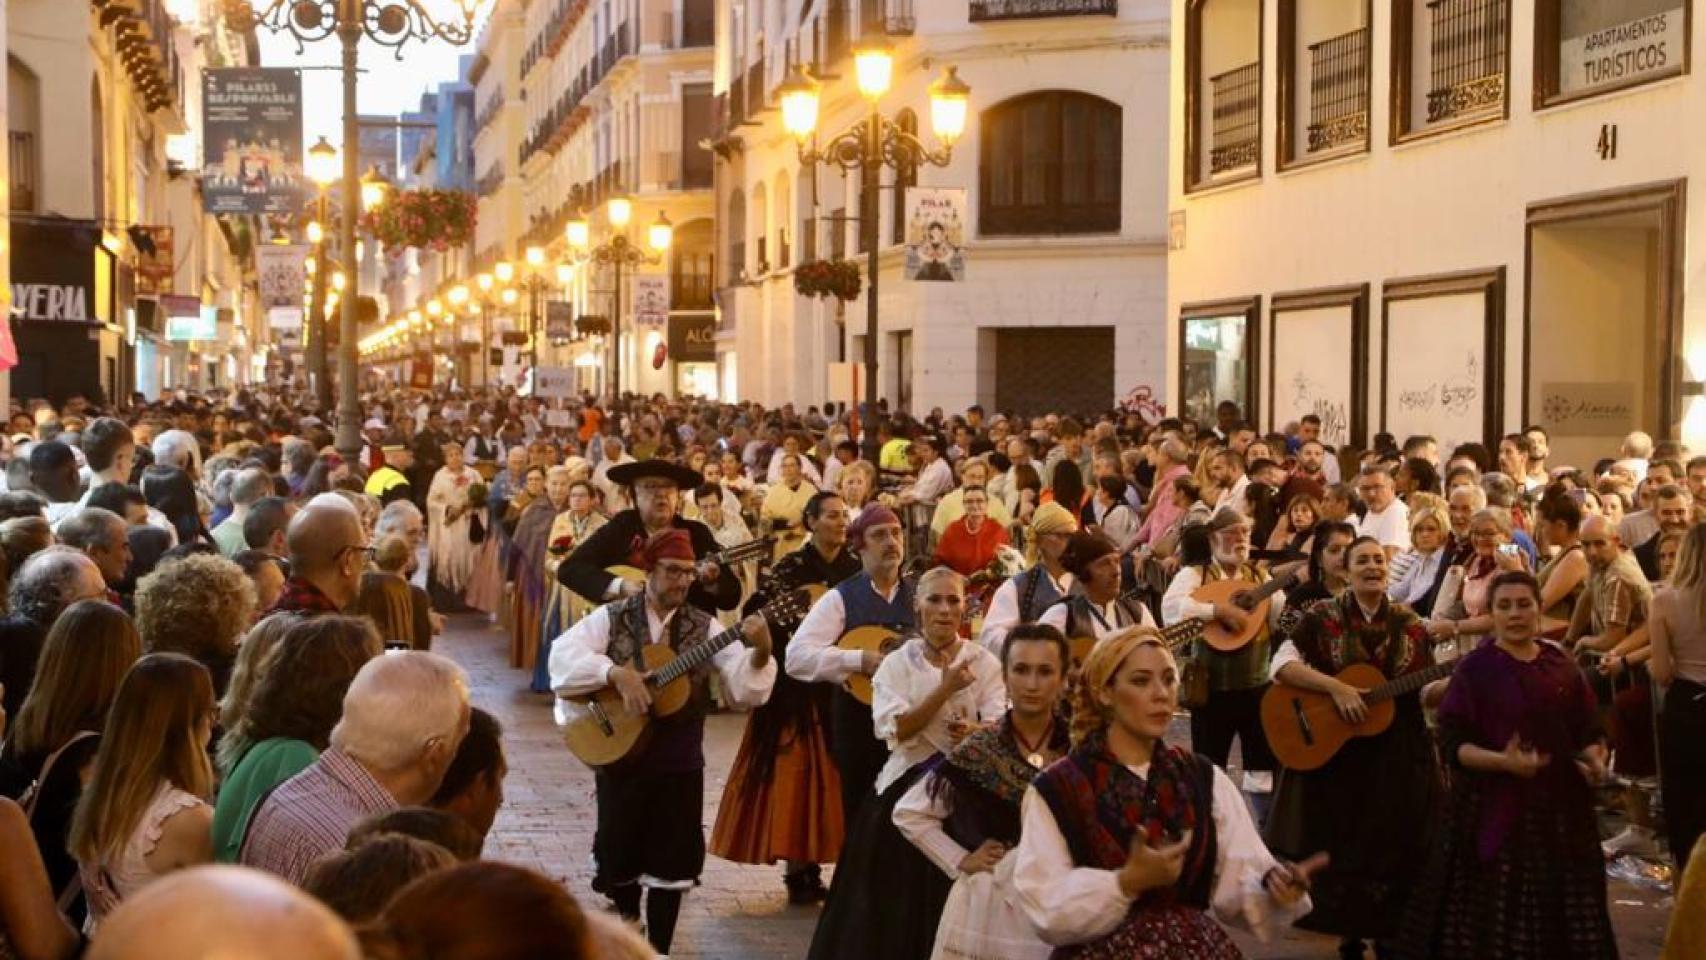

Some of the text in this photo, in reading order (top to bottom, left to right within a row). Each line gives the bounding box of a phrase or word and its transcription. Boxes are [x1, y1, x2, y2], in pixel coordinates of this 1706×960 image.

[1585, 14, 1667, 51] APARTAMENTOS
[1584, 41, 1667, 84] TURÍSTICOS
[1597, 124, 1617, 160] 41
[921, 198, 952, 208] PILAR
